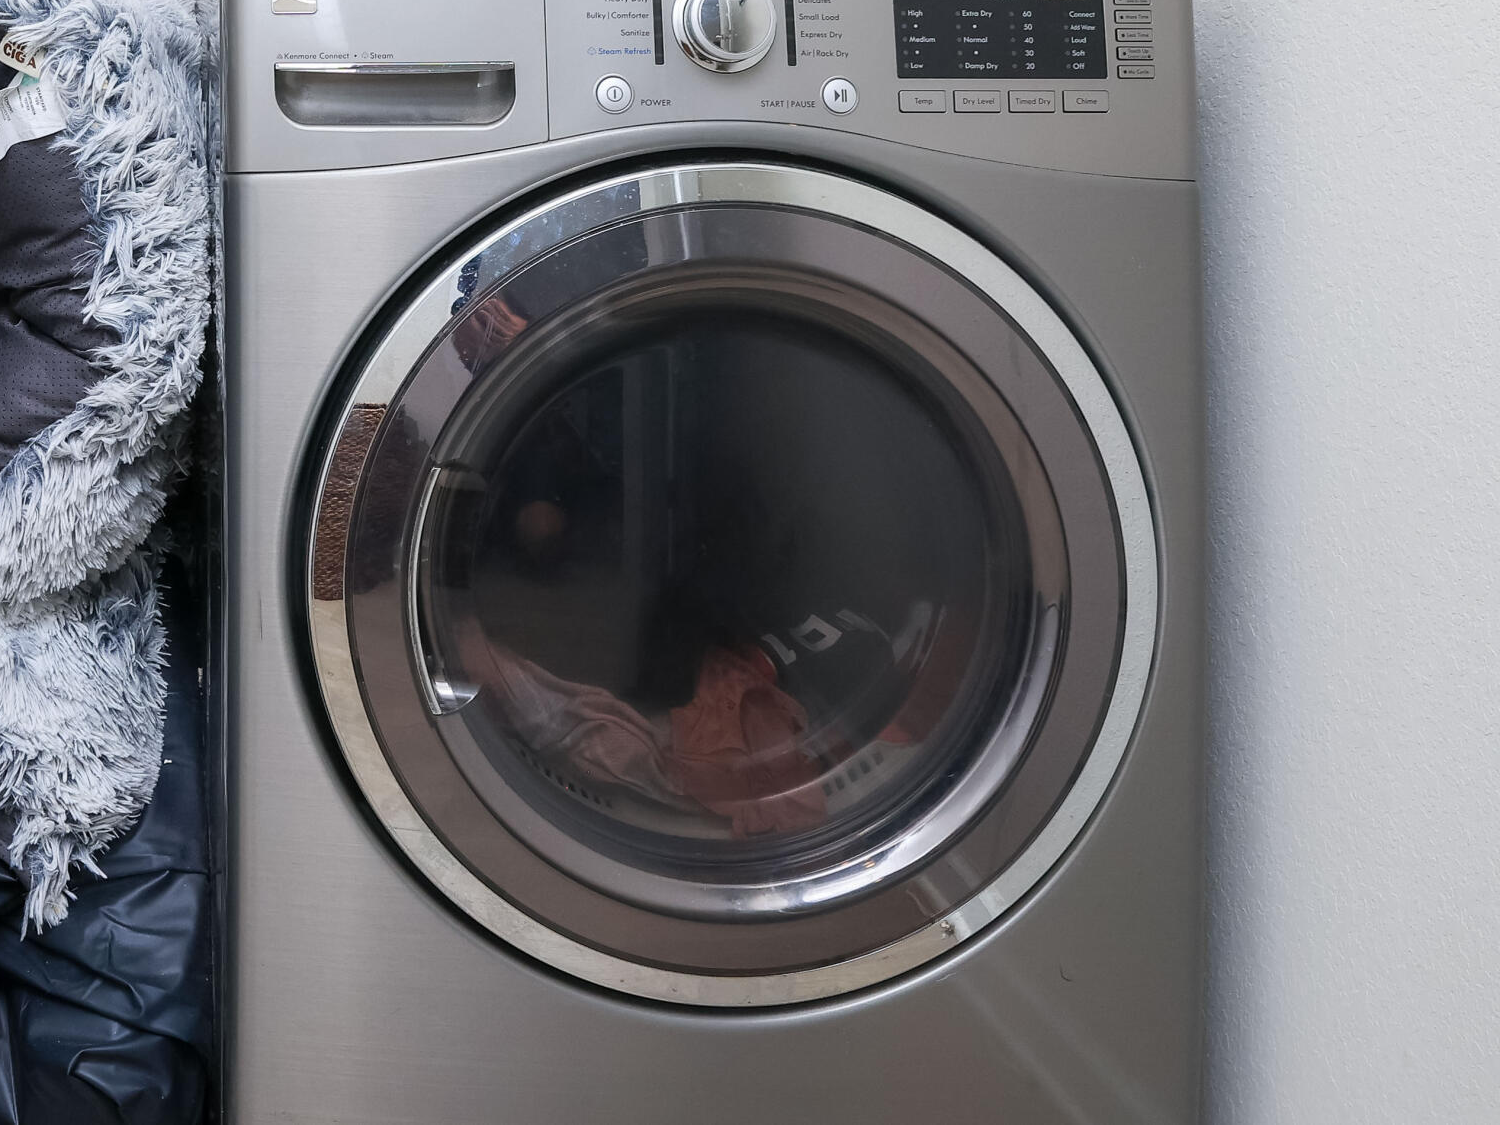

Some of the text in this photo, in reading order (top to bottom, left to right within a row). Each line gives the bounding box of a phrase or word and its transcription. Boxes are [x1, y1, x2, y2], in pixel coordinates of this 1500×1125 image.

[798, 13, 840, 21] Small Load
[907, 9, 923, 18] High
[980, 10, 993, 18] Dry
[1022, 10, 1032, 18] 60
[1023, 23, 1033, 31] 50
[620, 29, 650, 37] Sanitize
[800, 31, 843, 39] Express Dry
[1024, 36, 1034, 44] 40
[597, 47, 652, 55] Steam Refresh
[836, 50, 849, 58] Dry
[1024, 49, 1034, 57] 30
[1072, 49, 1086, 57] Soft
[284, 52, 394, 60] Kenmore Connect Steam
[965, 62, 999, 70] Damp Dry
[1025, 62, 1035, 70] 20
[1072, 62, 1085, 70] Off
[760, 100, 816, 108] START PAUSE
[915, 97, 933, 105] Temp
[962, 97, 995, 105] Dry Level
[1038, 98, 1051, 106] Dry
[1075, 97, 1098, 105] Chime
